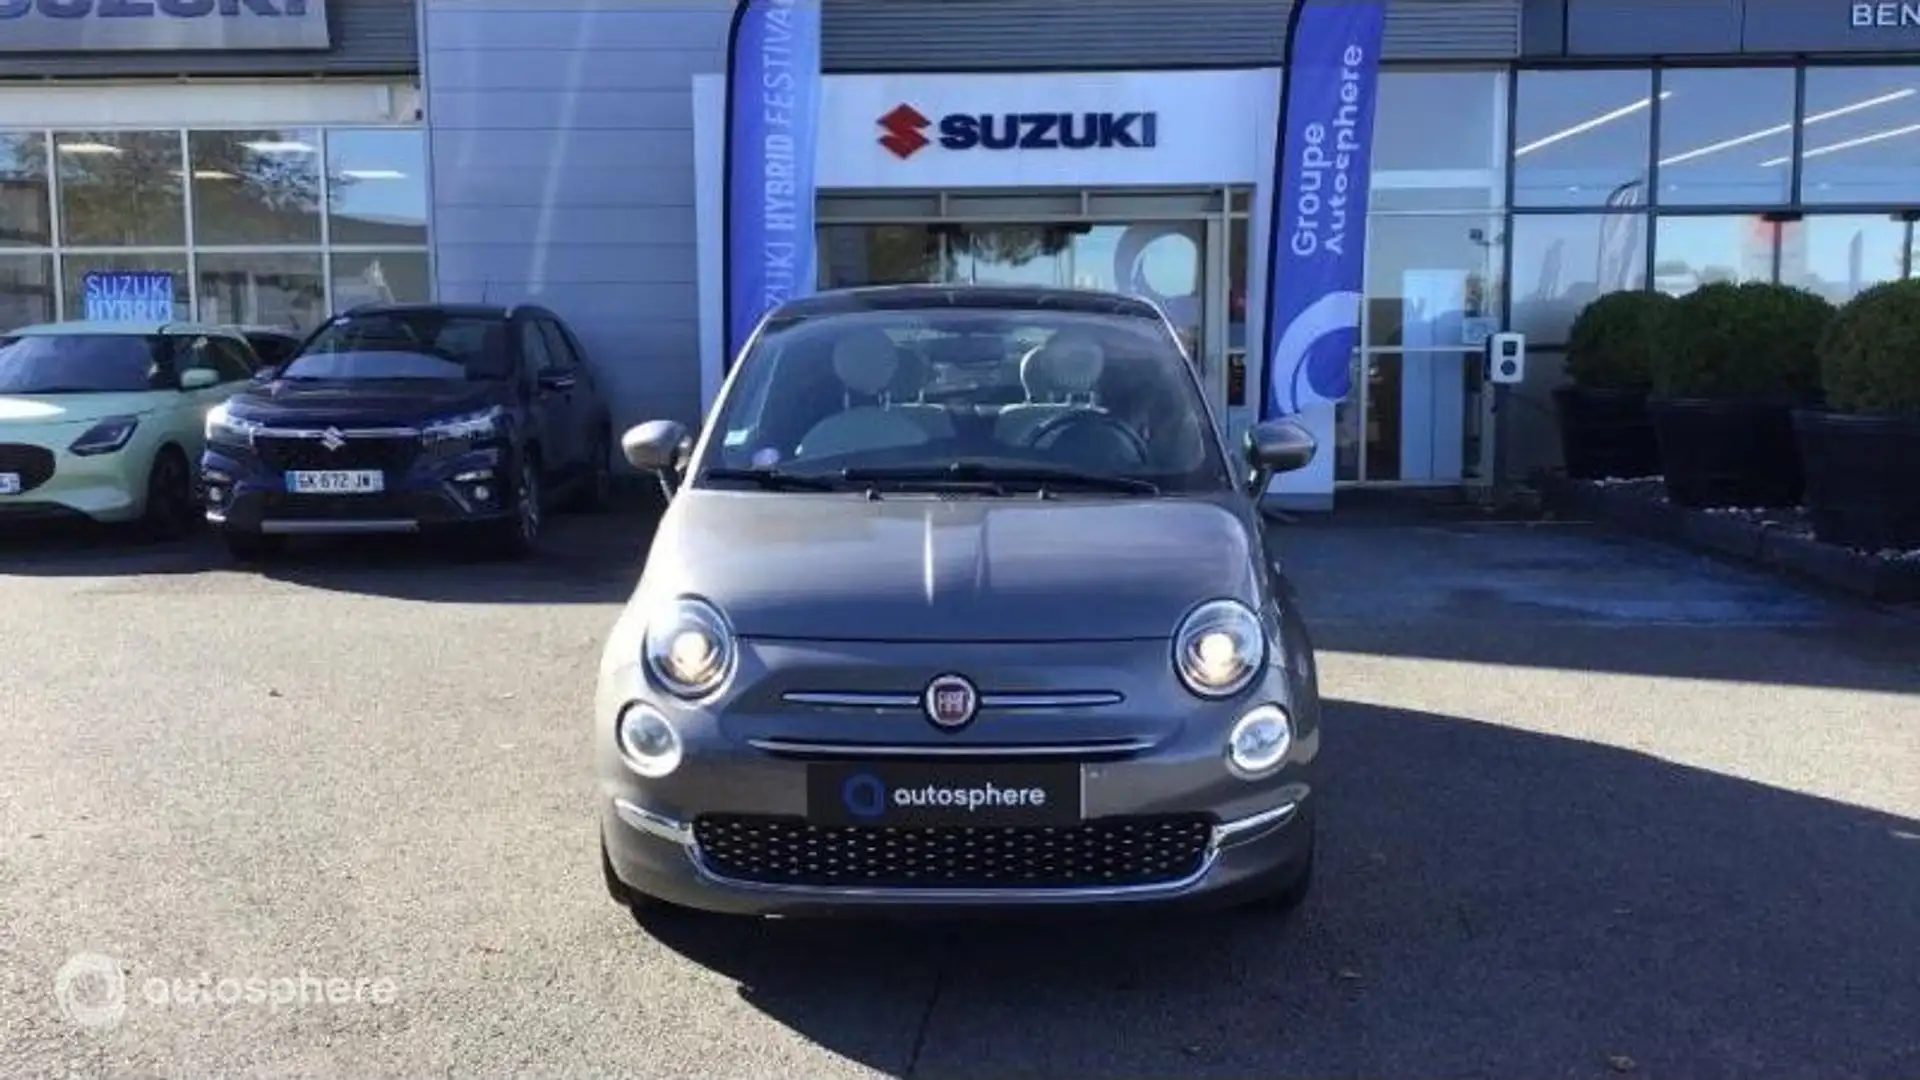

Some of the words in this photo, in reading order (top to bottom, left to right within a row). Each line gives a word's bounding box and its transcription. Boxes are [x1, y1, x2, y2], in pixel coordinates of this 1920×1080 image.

[1852, 3, 1920, 26] BEN
[763, 0, 796, 127] FESTIVA
[939, 111, 1158, 150] SUZUKI
[1324, 43, 1364, 255] Autosphere
[764, 133, 796, 231] HYBRID
[1291, 120, 1334, 256] Groupe
[86, 275, 172, 299] SUZUKI
[764, 241, 796, 309] ZUKI
[894, 781, 1046, 812] autosphere
